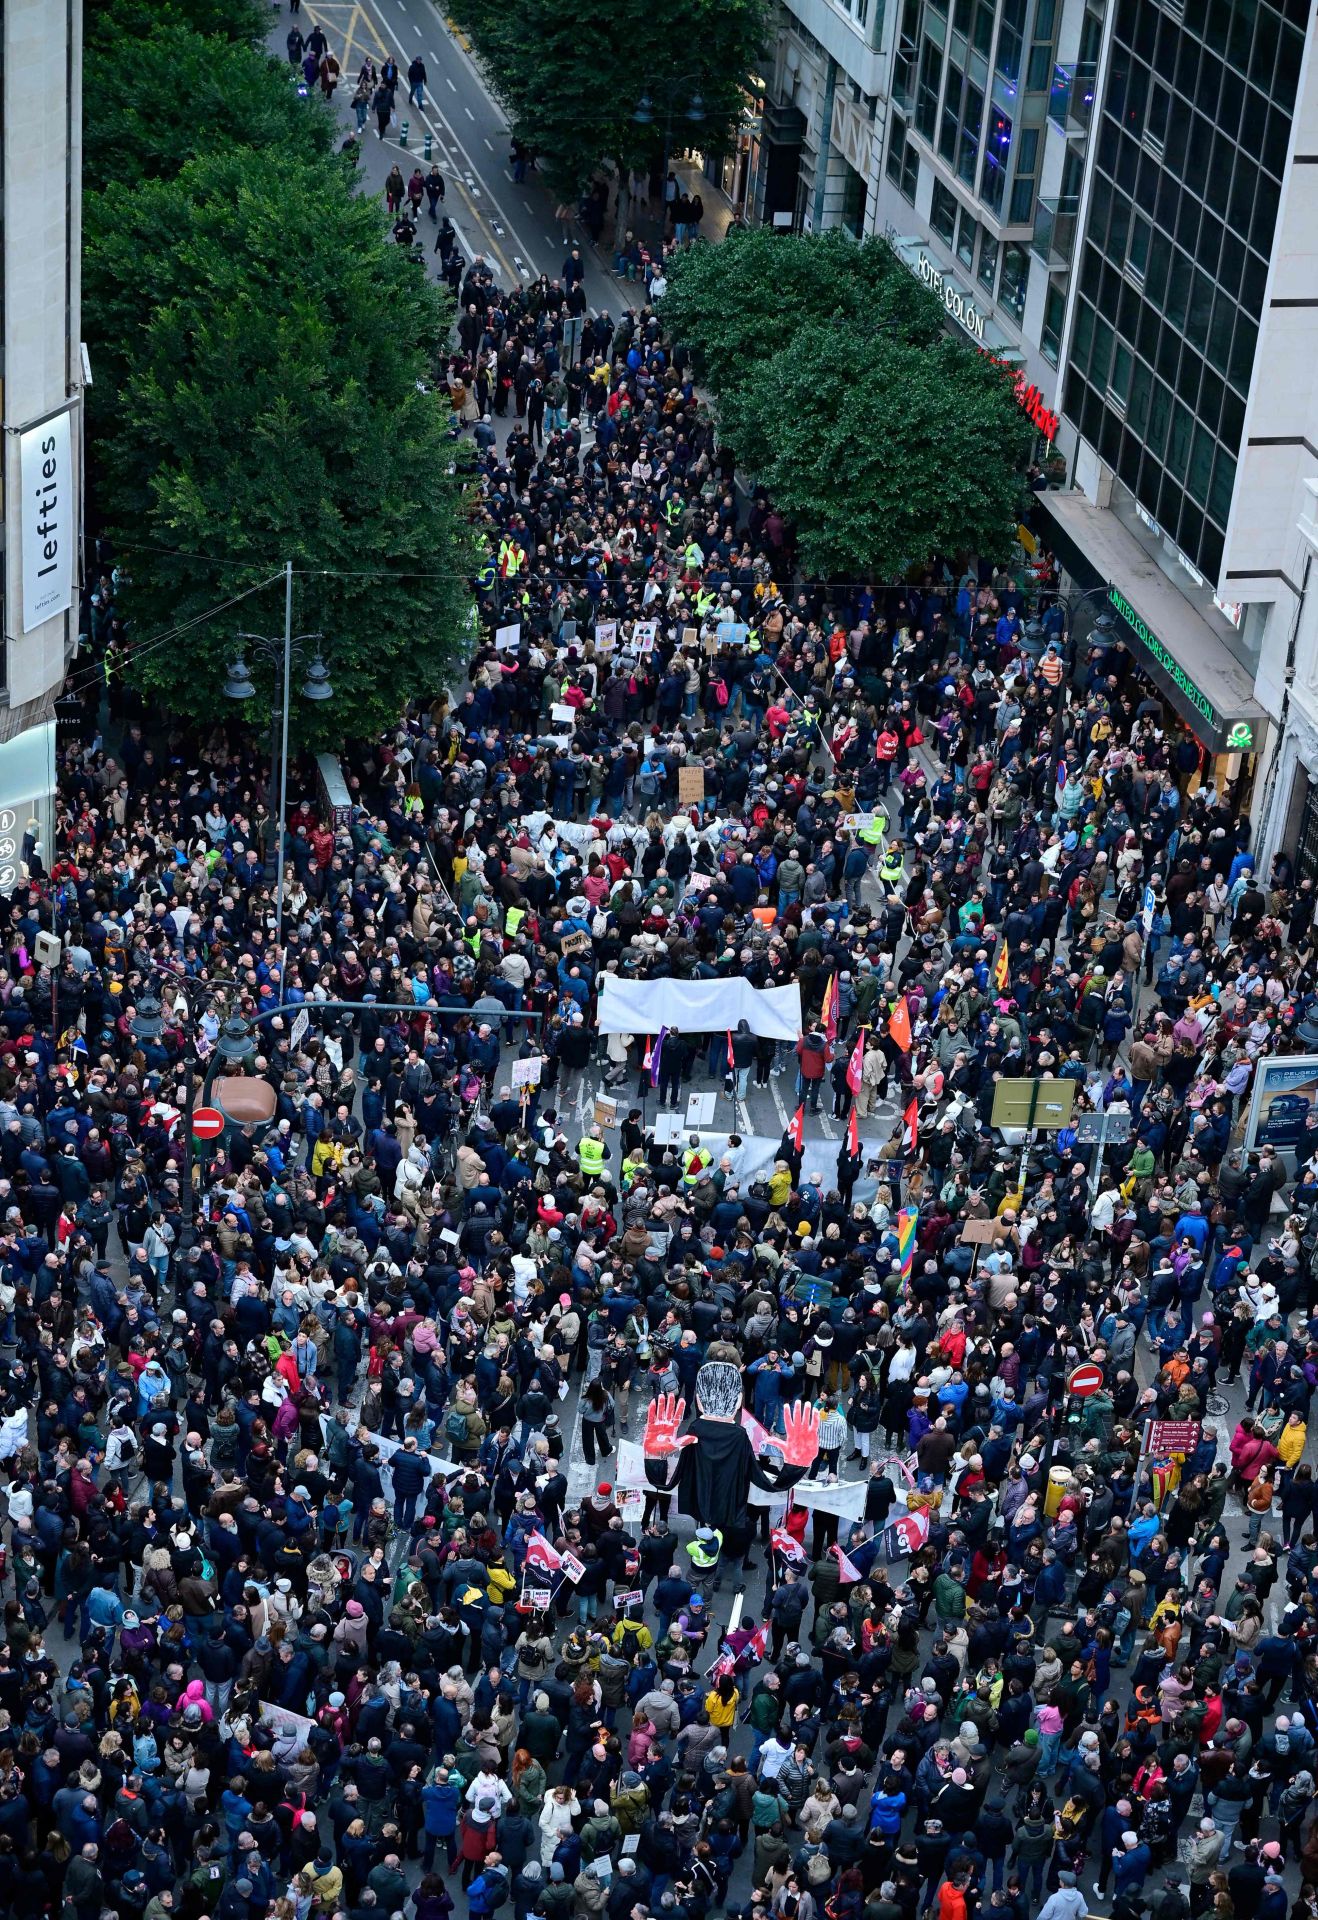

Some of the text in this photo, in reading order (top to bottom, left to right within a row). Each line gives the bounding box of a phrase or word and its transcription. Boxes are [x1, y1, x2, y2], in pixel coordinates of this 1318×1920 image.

[918, 250, 984, 339] HOTEL COLÓN
[35, 435, 58, 578] lefties
[1110, 588, 1135, 627] UNITED
[1135, 618, 1163, 662] COLORS
[1162, 654, 1175, 676] OF
[896, 1523, 913, 1555] CGT
